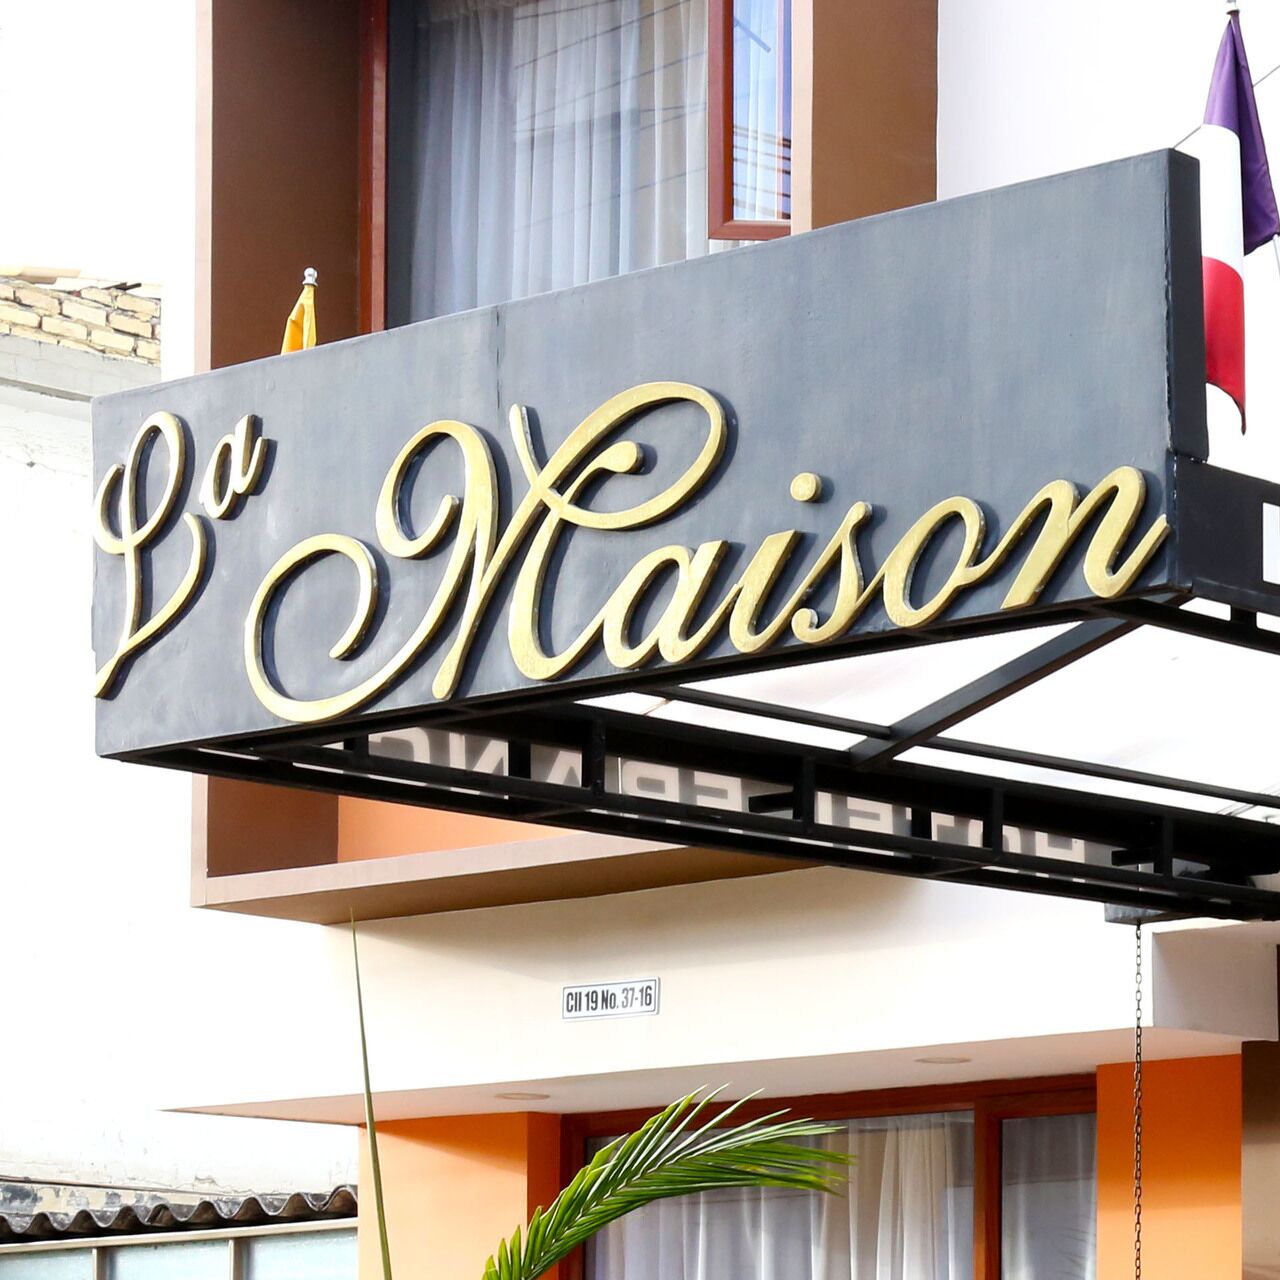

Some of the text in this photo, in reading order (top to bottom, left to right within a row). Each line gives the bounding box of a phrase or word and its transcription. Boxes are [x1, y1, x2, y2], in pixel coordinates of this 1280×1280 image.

[93, 380, 1171, 723] La Maison
[585, 990, 599, 1012] 19
[601, 989, 619, 1011] No.
[621, 985, 652, 1009] 37-16
